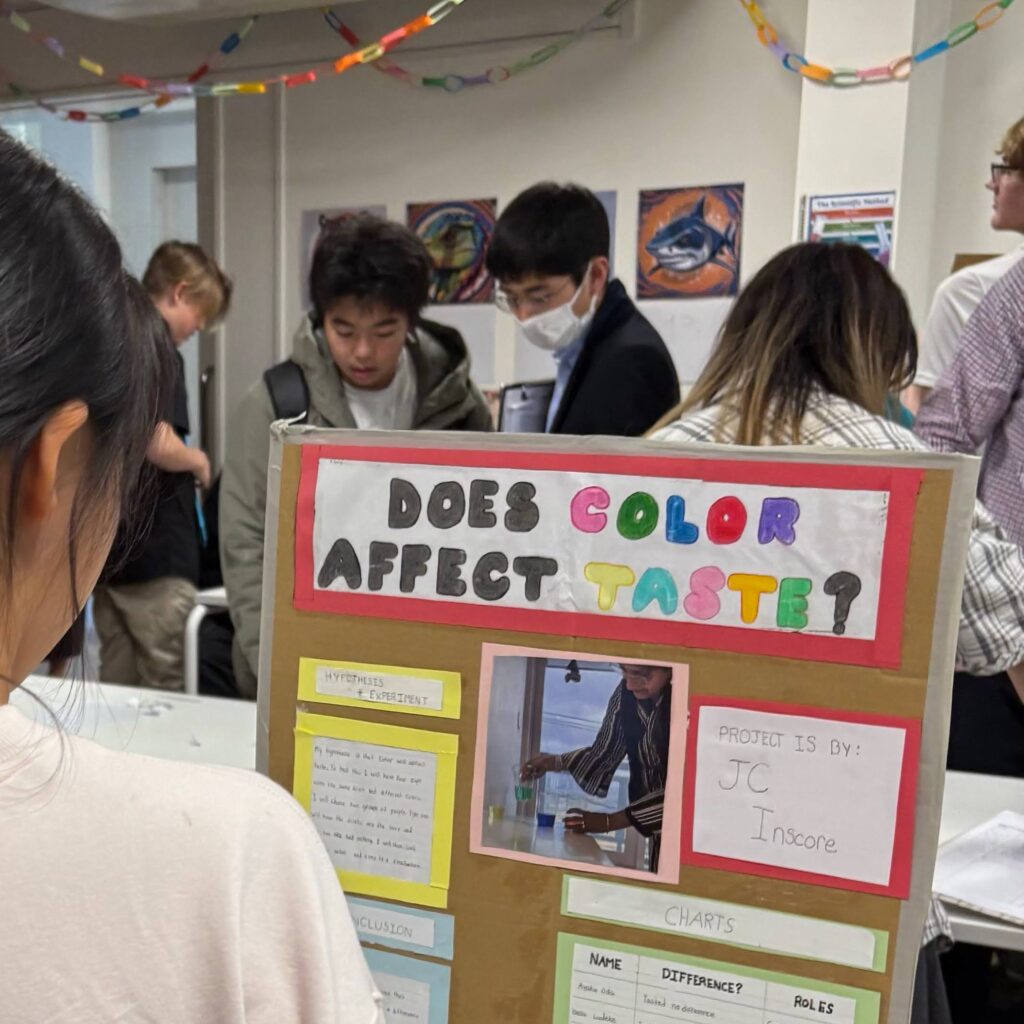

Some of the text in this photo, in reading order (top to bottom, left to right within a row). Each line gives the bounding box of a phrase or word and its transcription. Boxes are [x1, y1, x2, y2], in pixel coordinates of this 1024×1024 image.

[387, 477, 801, 545] DOES COLOR
[317, 538, 862, 635] AFFECT TASTE?
[719, 725, 784, 748] PROJECT
[795, 735, 817, 753] IS
[719, 758, 770, 793] JC
[751, 805, 838, 854] Inscore
[352, 915, 413, 937] NCLUSION
[664, 905, 736, 933] CHARTS
[589, 952, 623, 971] NAME
[661, 967, 744, 995] DIFFERENCE?
[794, 995, 834, 1015] ROLES
